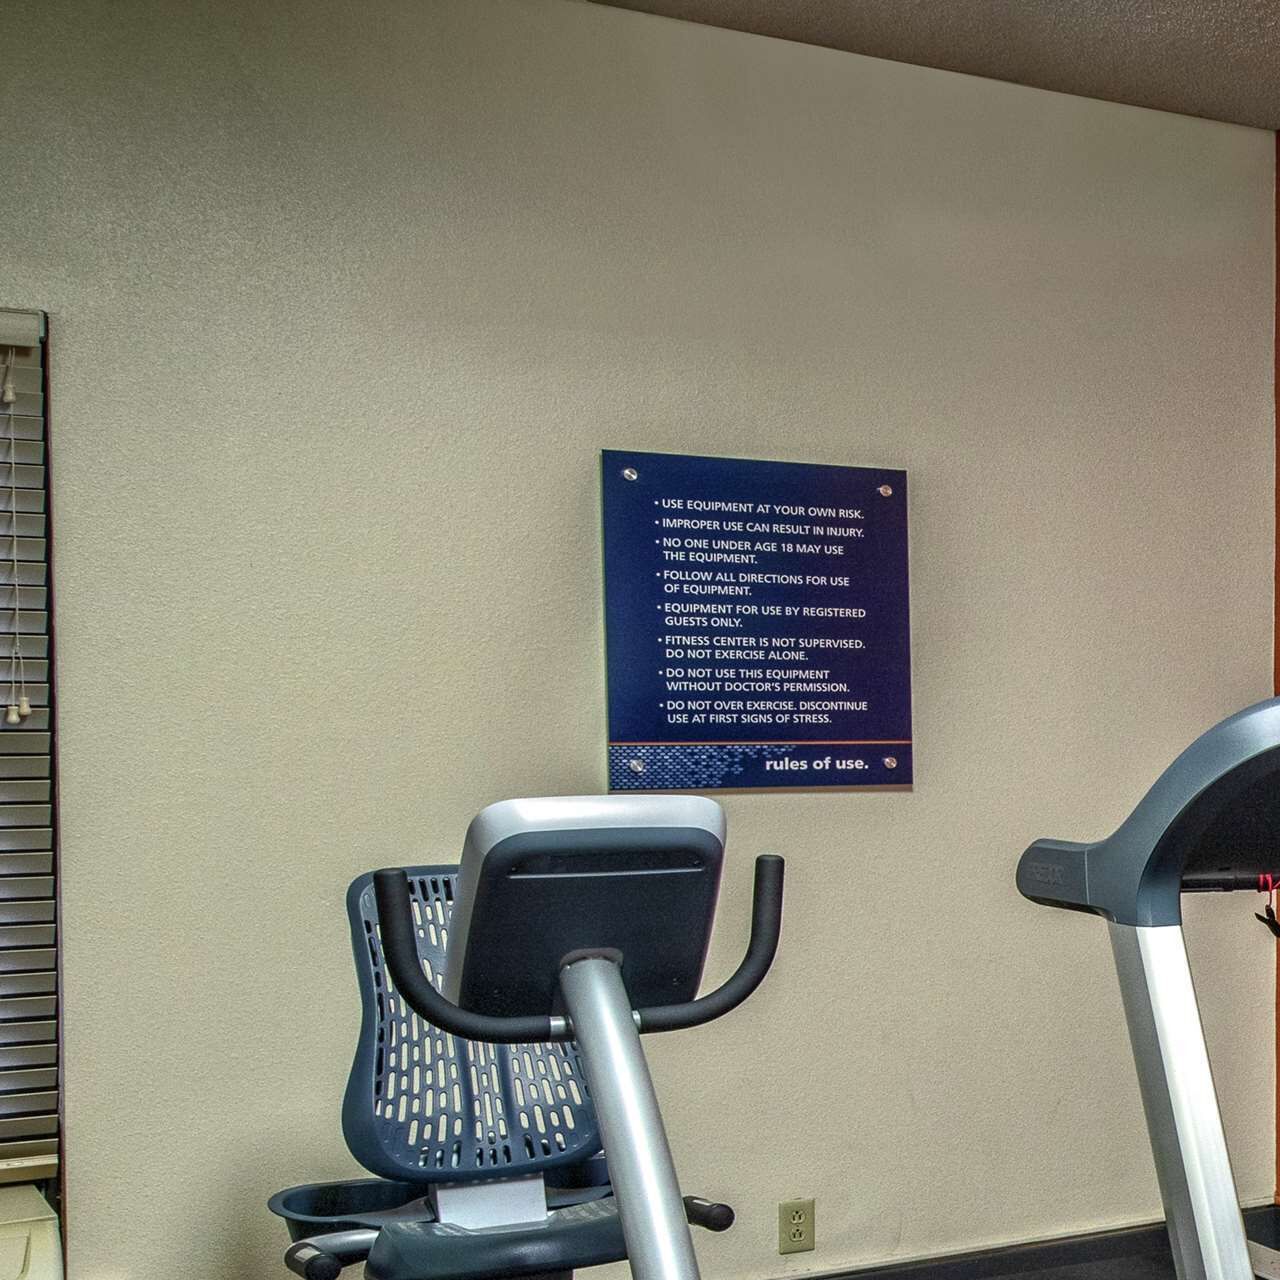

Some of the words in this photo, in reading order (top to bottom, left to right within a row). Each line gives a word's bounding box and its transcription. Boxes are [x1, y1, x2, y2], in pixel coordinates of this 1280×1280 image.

[662, 498, 684, 509] USE
[686, 499, 754, 513] EQUIPMENT
[756, 504, 771, 514] AT
[773, 504, 806, 516] YOUR
[807, 506, 836, 518] OWN
[838, 508, 866, 519] RISK.
[662, 518, 721, 530] IMPROPER
[722, 521, 744, 532] USE
[746, 522, 770, 533] CAN
[772, 523, 811, 535] RESULT
[812, 525, 824, 536] IN
[826, 526, 865, 538] INJURY.
[663, 537, 682, 548] NO
[684, 538, 709, 549] ONE
[712, 539, 752, 551] UNDER
[754, 541, 777, 552] AGE
[781, 543, 794, 553] 18
[796, 543, 822, 554] MAY
[824, 545, 844, 555] USE
[662, 550, 686, 561] THE
[689, 551, 759, 564] EQUIPMENT.
[663, 569, 713, 581] FOLLOW
[715, 572, 737, 582] ALL
[738, 572, 804, 585] DIRECTIONS
[805, 575, 828, 586] FOR
[830, 576, 850, 587] USE
[663, 583, 680, 593] OF
[683, 583, 752, 596] EQUIPMENT.
[664, 602, 734, 614] EQUIPMENT
[735, 604, 759, 615] FOR
[761, 605, 782, 616] USE
[785, 606, 800, 616] BY
[802, 606, 866, 618] REGISTERED
[664, 615, 708, 627] GUESTS
[710, 617, 743, 628] ONLY.
[665, 635, 710, 646] FITNESS
[712, 636, 757, 647] CENTER
[759, 637, 769, 647] IS
[771, 637, 796, 648] NOT
[798, 638, 866, 649] SUPERVISED.
[665, 648, 685, 659] DO
[687, 649, 713, 659] NOT
[714, 649, 765, 660] EXERCISE
[768, 650, 809, 661] ALONE.
[666, 667, 685, 678] DO
[687, 668, 713, 678] NOT
[715, 668, 736, 679] USE
[738, 668, 764, 679] THIS
[766, 669, 830, 680] EQUIPMENT
[666, 681, 722, 691] WITHOUT
[724, 681, 781, 692] DOCTOR'S
[783, 682, 851, 693] PERMISSION.
[666, 700, 685, 711] DO
[687, 700, 712, 711] NOT
[713, 700, 744, 711] OVER
[746, 700, 797, 711] EXERCISE.
[799, 701, 868, 711] DISCONTINUE
[667, 713, 689, 724] USE
[691, 713, 707, 723] AT
[709, 713, 739, 724] FIRST
[740, 713, 773, 724] SIGNS
[775, 713, 790, 723] OF
[792, 713, 834, 724] STRESS.
[765, 756, 808, 771] rules
[812, 756, 832, 770] of
[835, 759, 869, 770] use.
